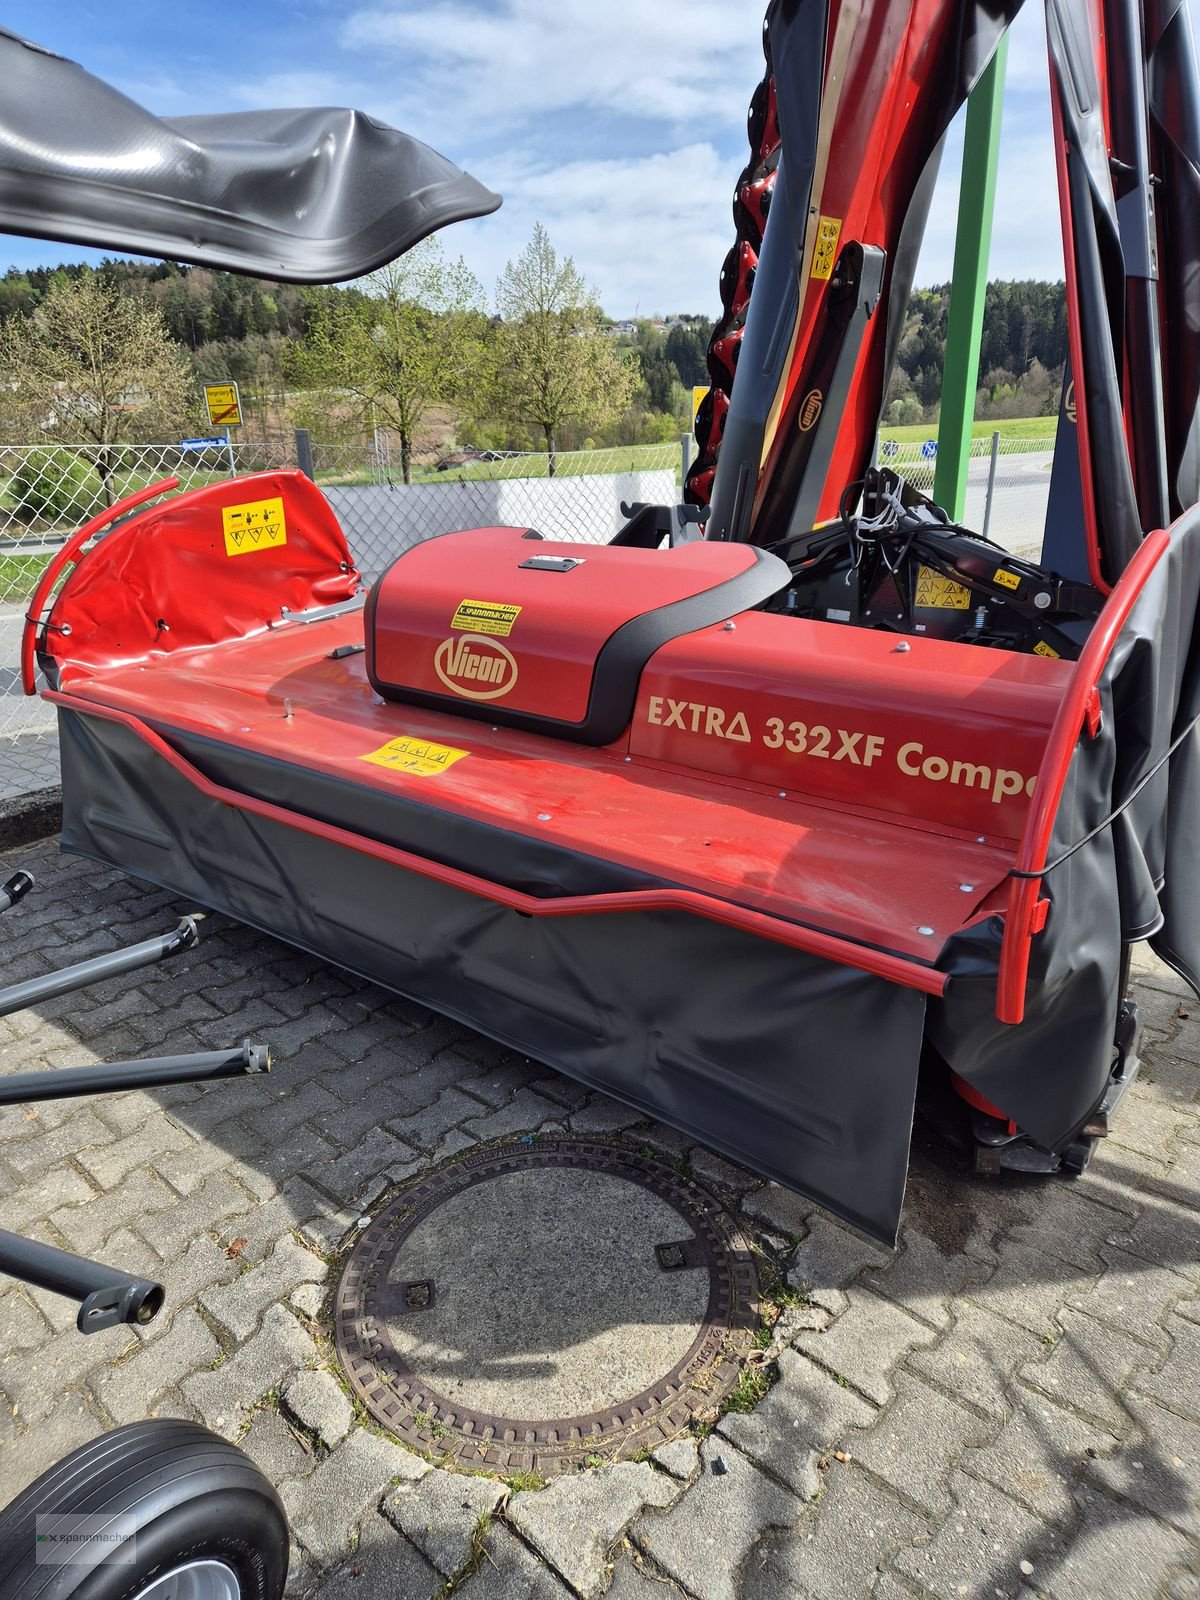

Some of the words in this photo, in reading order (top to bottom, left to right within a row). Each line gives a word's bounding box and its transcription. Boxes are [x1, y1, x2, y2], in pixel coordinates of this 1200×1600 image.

[801, 392, 822, 428] Vicon
[442, 635, 511, 688] Vicon
[762, 717, 886, 767] 332XF
